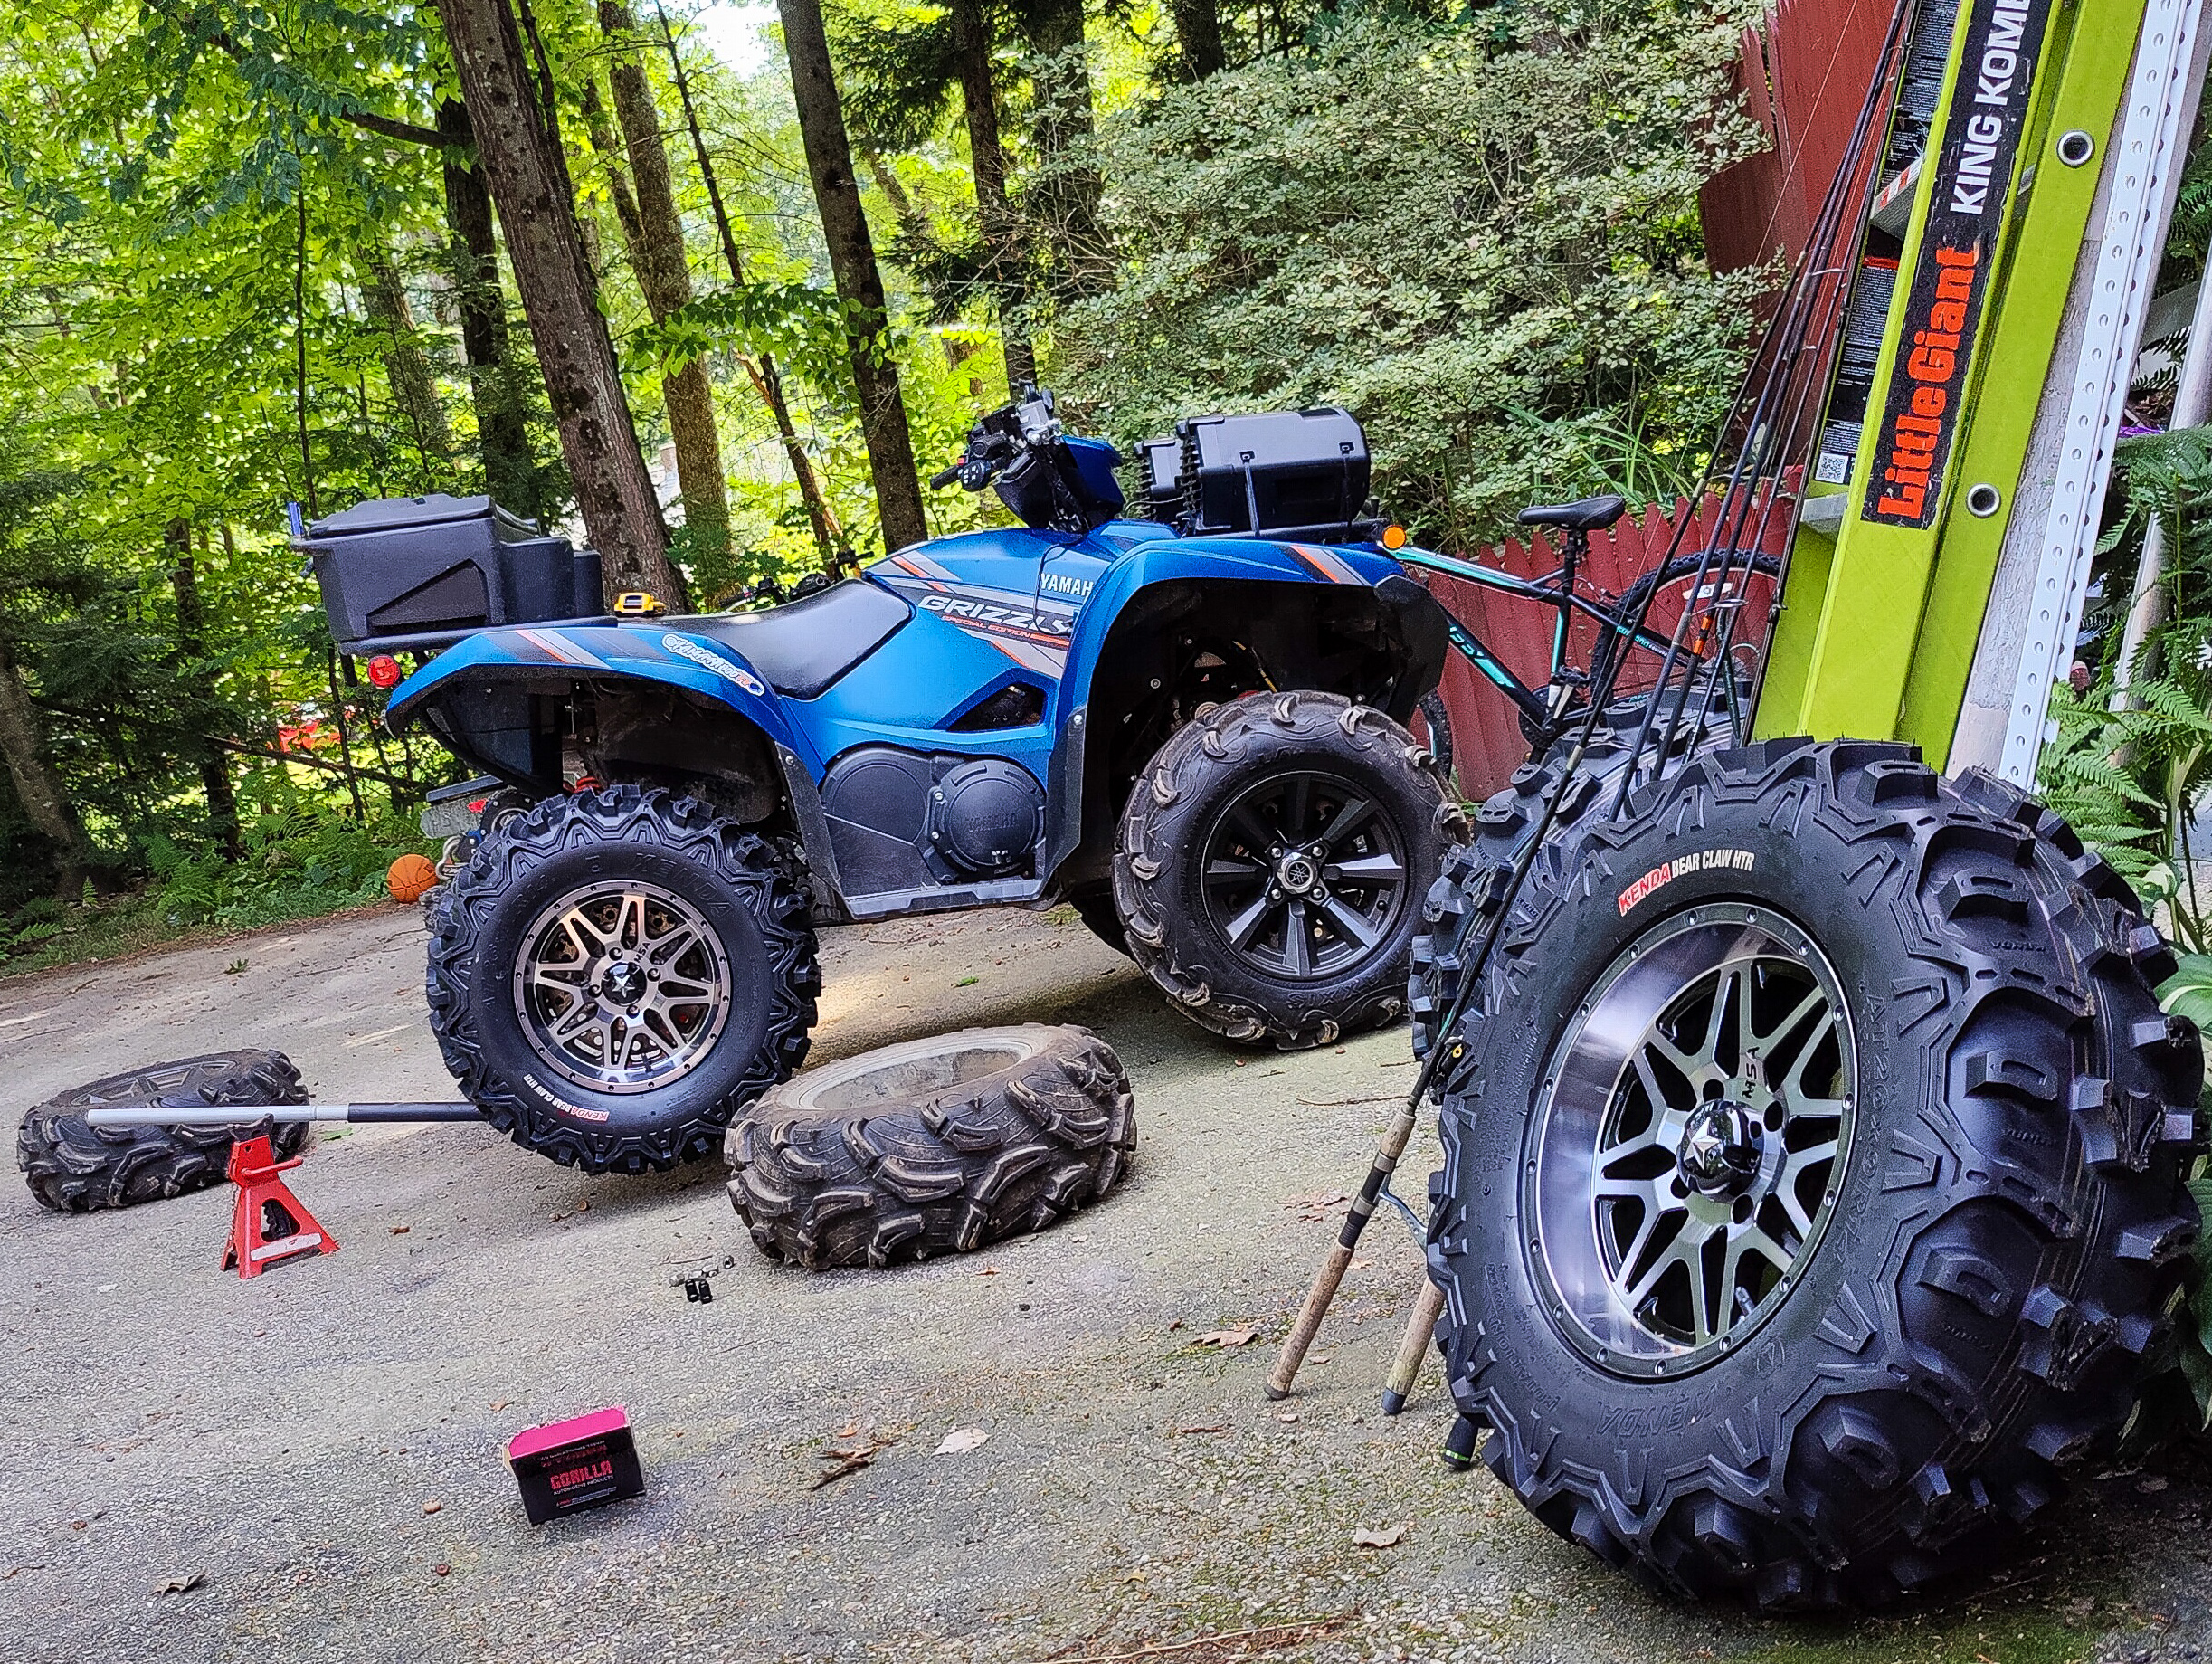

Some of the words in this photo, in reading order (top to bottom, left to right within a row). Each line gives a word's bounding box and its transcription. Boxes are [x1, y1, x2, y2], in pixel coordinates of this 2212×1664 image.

[1950, 115, 2002, 215] KING
[1041, 572, 1093, 597] YAMAH
[942, 613, 988, 630] SPECIAL
[988, 623, 1031, 638] EDITION
[1618, 862, 1672, 917] KENDA
[1671, 852, 1701, 879] BEAR
[1702, 849, 1733, 870] CLAW
[1732, 850, 1755, 871] HTR
[634, 942, 651, 964] MSA
[523, 1073, 539, 1089] HTR
[1742, 1046, 1761, 1099] MSA
[533, 1085, 555, 1102] CLAW
[551, 1097, 573, 1113] BEAR
[570, 1105, 610, 1122] KENDA
[1596, 1383, 1717, 1437] KENDA
[549, 1460, 612, 1491] GORILLA
[586, 1474, 614, 1487] PRODUCTS
